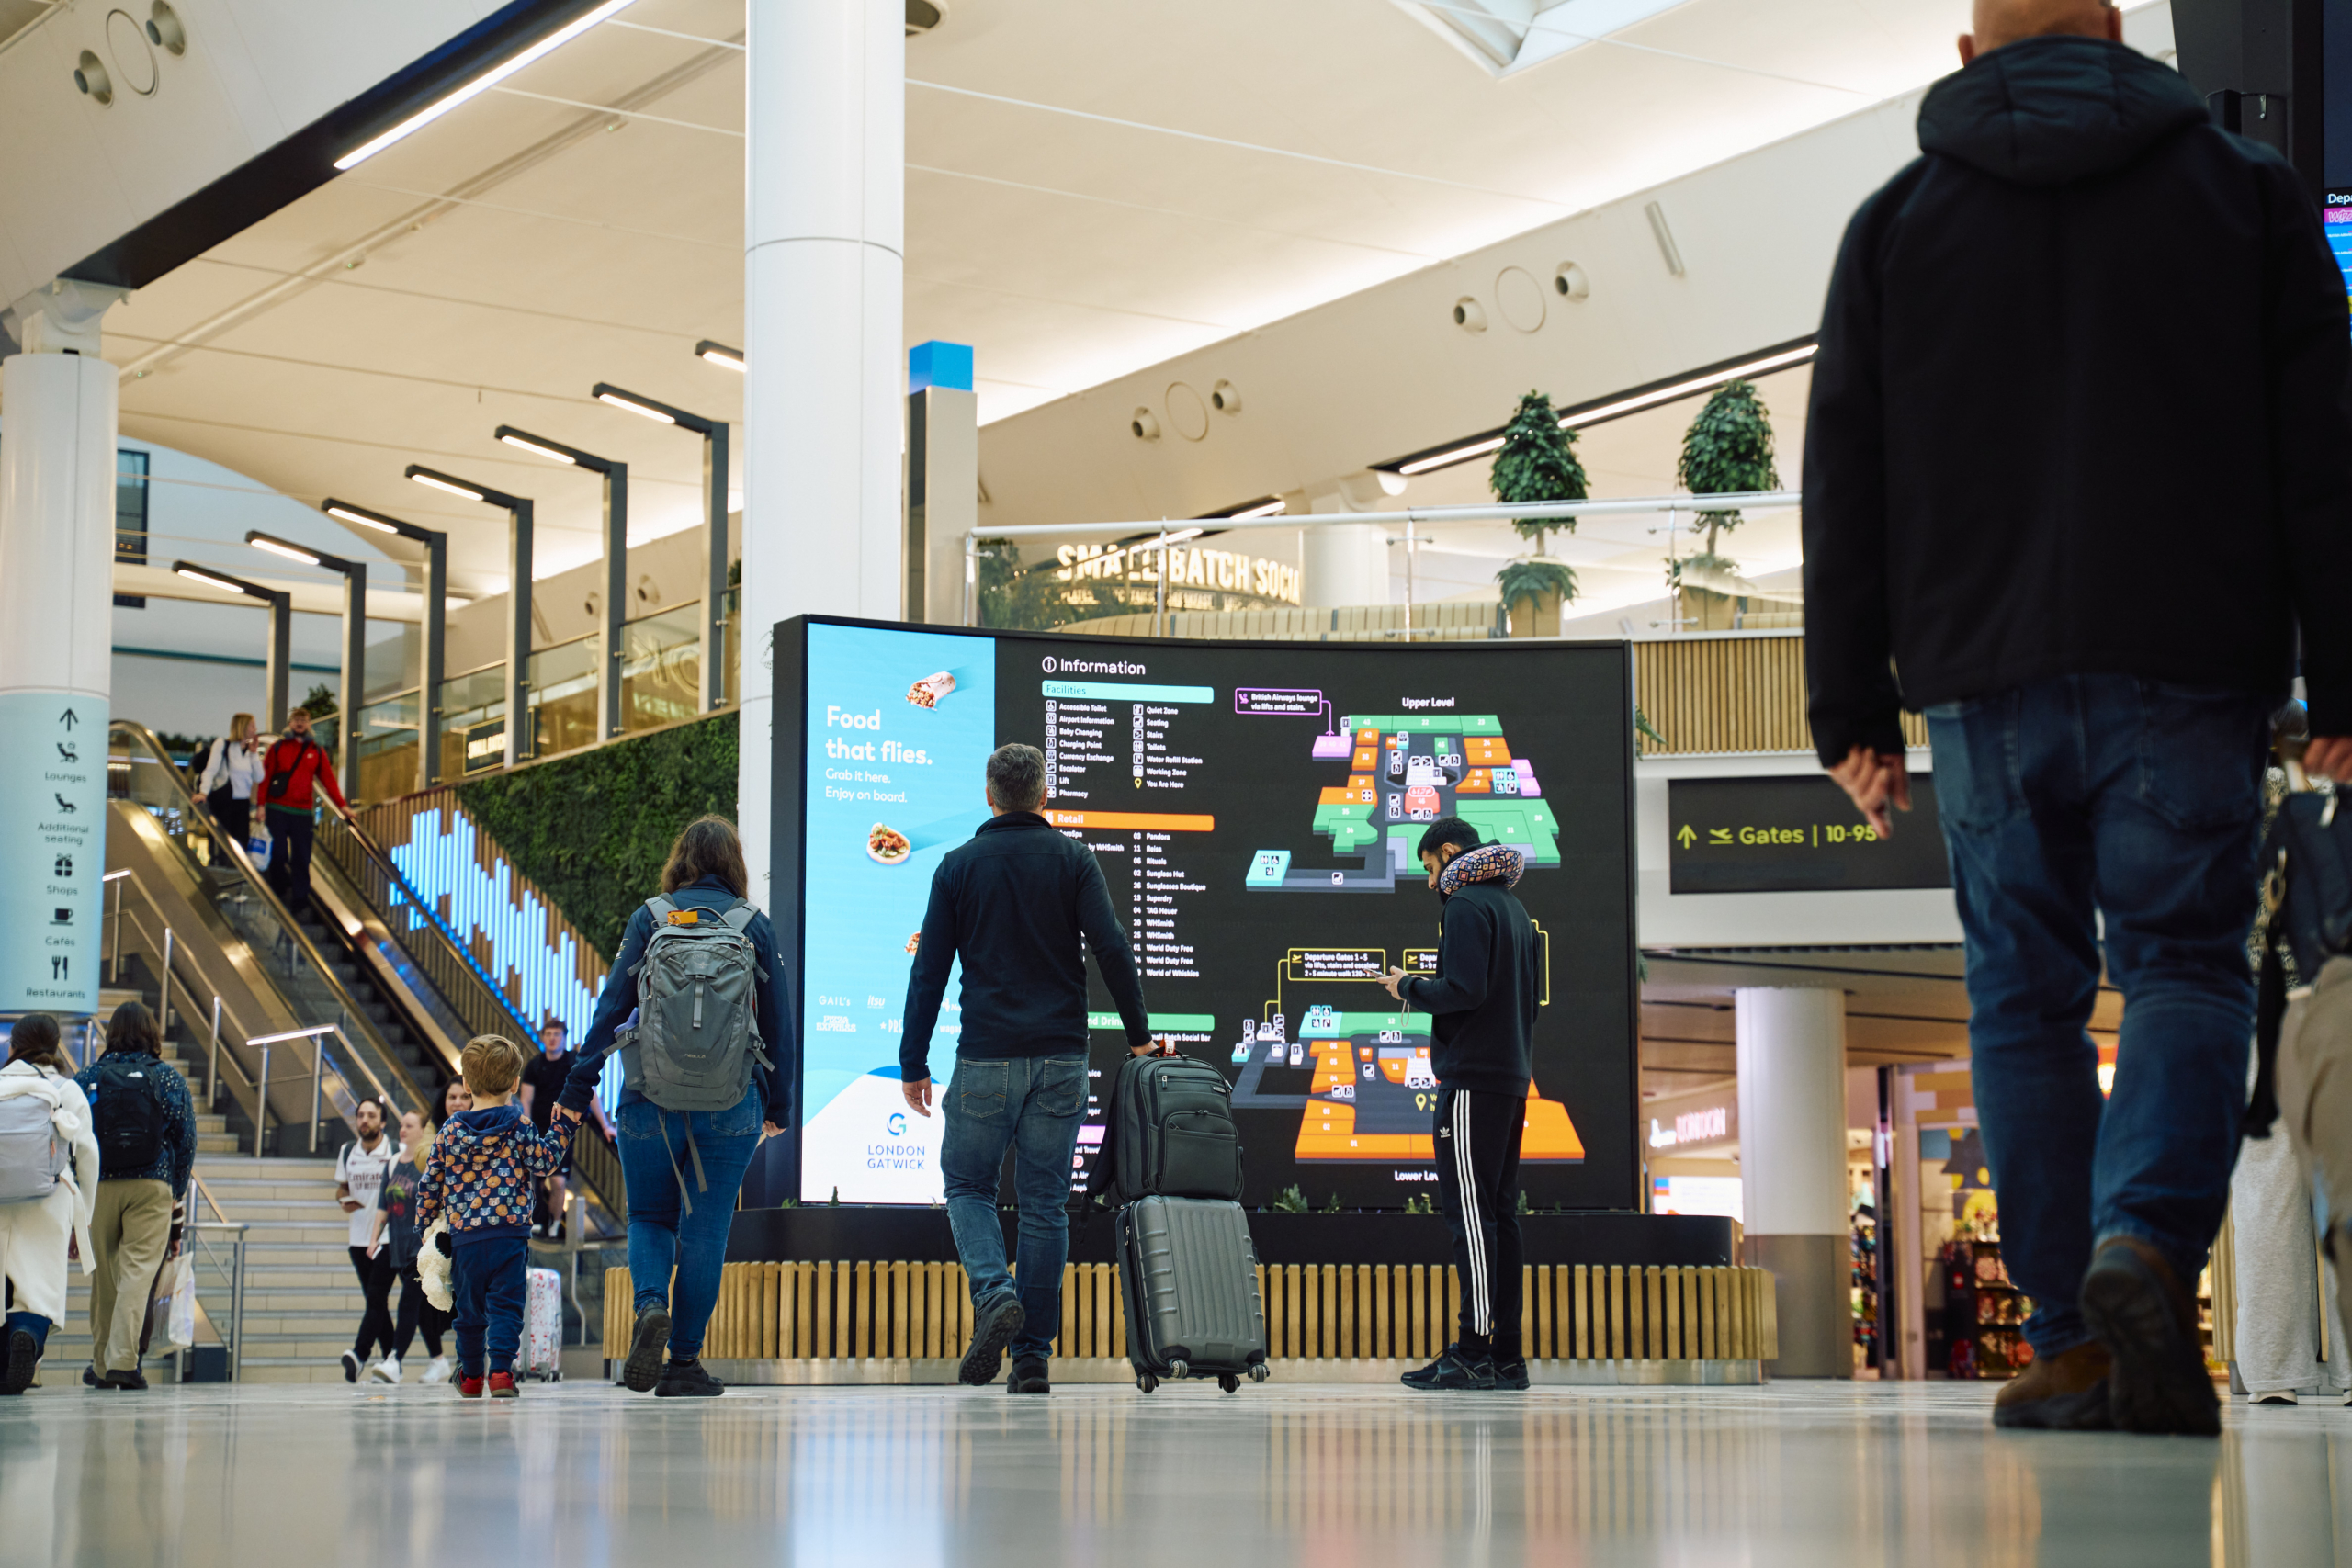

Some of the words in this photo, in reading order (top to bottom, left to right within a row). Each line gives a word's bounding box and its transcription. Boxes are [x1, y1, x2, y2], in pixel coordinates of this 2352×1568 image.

[1057, 544, 1159, 581] SMALL
[1169, 547, 1250, 591] BATCH
[1256, 558, 1300, 606] SOCIA
[1061, 658, 1146, 675] Information
[1046, 684, 1086, 695] Facilities
[1251, 693, 1271, 701] British
[1272, 694, 1295, 703] Airways
[1296, 694, 1317, 703] lounge
[1402, 697, 1430, 709] Upper
[1431, 697, 1455, 707] Level
[1059, 703, 1090, 712] Accessible
[1091, 705, 1107, 713] Toilet
[1147, 706, 1163, 716] Quiet
[1274, 703, 1285, 711] and
[827, 705, 880, 730] Food
[1059, 716, 1080, 725] Airport
[1080, 716, 1114, 726] Information
[1147, 718, 1169, 728] Seating
[1059, 728, 1074, 738] Baby
[1075, 728, 1102, 739] Changing
[1147, 731, 1163, 739] Stairs
[1059, 740, 1086, 750] Charging
[1086, 741, 1102, 750] Point
[1147, 743, 1166, 751] Toilets
[826, 737, 876, 761] that
[880, 740, 933, 764] flies.
[1059, 752, 1085, 761] Currency
[1086, 753, 1114, 763] Exchange
[1147, 756, 1165, 764] Water
[1165, 756, 1181, 764] Refill
[1182, 756, 1203, 765] Station
[1059, 764, 1086, 773] Escalator
[1147, 768, 1171, 777] Working
[45, 772, 86, 784] Lounges
[825, 768, 853, 781] Grab
[854, 770, 863, 782] it
[865, 771, 891, 784] here.
[1059, 776, 1069, 784] Lift
[1147, 780, 1158, 788] You
[1158, 780, 1169, 788] Are
[1170, 781, 1184, 789] Here
[825, 786, 854, 801] Enjoy
[856, 791, 871, 800] on
[873, 789, 908, 803] board.
[1059, 789, 1088, 799] Pharmacy
[1058, 814, 1084, 824] Retail
[38, 822, 89, 834] Additional
[1147, 832, 1170, 841] Pandora
[1738, 826, 1804, 845] Gates
[1826, 824, 1877, 843] 10-95
[45, 835, 83, 847] seating
[1096, 843, 1125, 852] WHSmith
[1147, 845, 1162, 853] Reiss
[1147, 857, 1167, 865] Rituals
[1147, 870, 1172, 879] Sunglass
[47, 885, 78, 897] Shops
[1147, 882, 1179, 892] Sunglasses
[1180, 884, 1206, 892] Boutique
[1147, 895, 1172, 904] Superdry
[1147, 907, 1159, 915] TAG
[1147, 919, 1174, 928] WHSmith
[1147, 931, 1174, 940] WHSmith
[45, 936, 75, 946] Cafés
[1147, 943, 1164, 953] World
[1165, 944, 1179, 953] Duty
[1147, 956, 1164, 964] World
[1165, 956, 1179, 965] Duty
[1305, 953, 1335, 962] Departure
[1172, 969, 1199, 977] Whiskies
[26, 987, 85, 999] Restaurants
[819, 995, 851, 1007] GAIL's
[867, 995, 886, 1007] itsu
[823, 1015, 849, 1024] PIZZA
[1102, 1017, 1123, 1026] Drin
[816, 1022, 856, 1032] EXPRESS
[888, 1019, 904, 1033] PRE
[940, 1025, 962, 1035] waga
[1182, 1033, 1199, 1042] Social
[867, 1145, 925, 1156] LONDON
[867, 1158, 925, 1170] GATWICK
[1395, 1170, 1422, 1181] Lower
[1424, 1170, 1439, 1181] Lev
